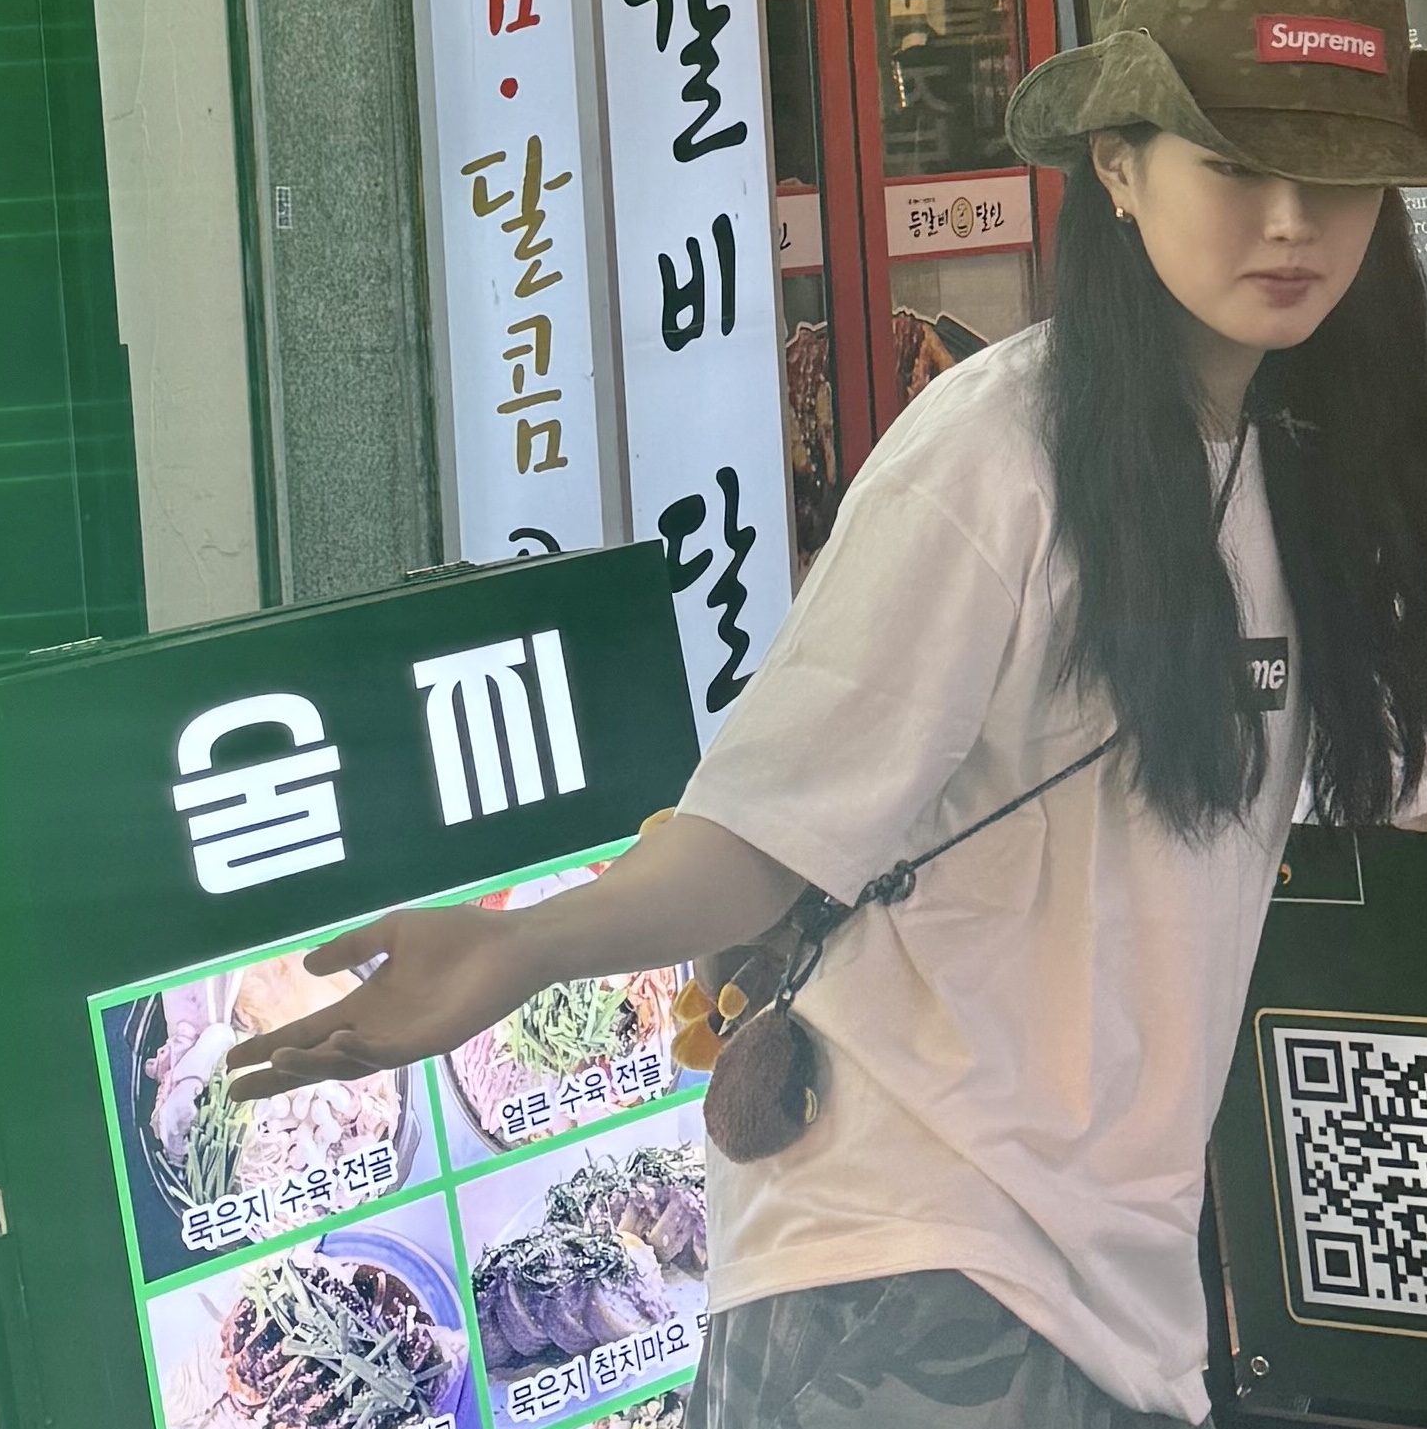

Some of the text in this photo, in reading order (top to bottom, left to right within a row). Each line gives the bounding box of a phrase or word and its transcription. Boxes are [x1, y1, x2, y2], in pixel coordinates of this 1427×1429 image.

[1271, 22, 1377, 59] Supreme
[908, 201, 1004, 237] 등갈비 달인
[503, 1056, 663, 1134] 얼큰 수육 전골
[184, 1148, 395, 1245] 묵은지 수육 전골
[511, 1360, 591, 1416] 묵은지
[593, 1323, 691, 1382] 참치마요
